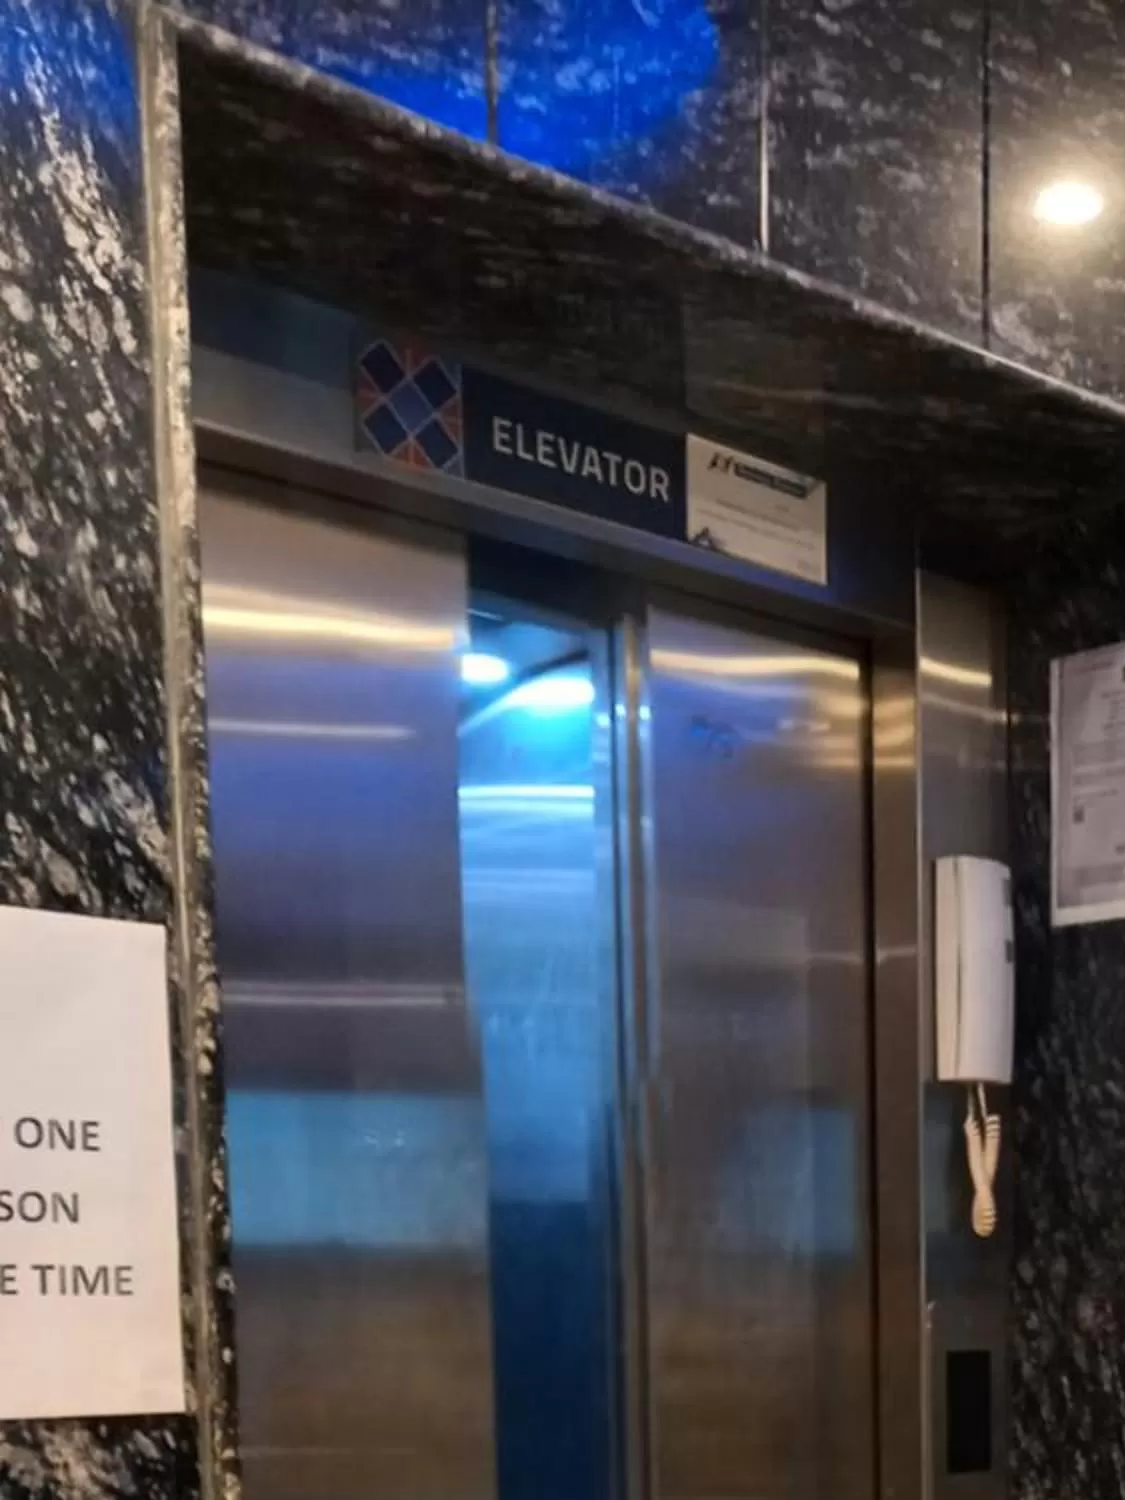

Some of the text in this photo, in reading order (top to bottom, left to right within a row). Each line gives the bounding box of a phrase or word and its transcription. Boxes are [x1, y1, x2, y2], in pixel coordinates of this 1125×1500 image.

[492, 415, 671, 503] ELEVATOR
[13, 1116, 102, 1152] ONE
[0, 1189, 80, 1224] SON
[30, 1264, 134, 1297] TIME
